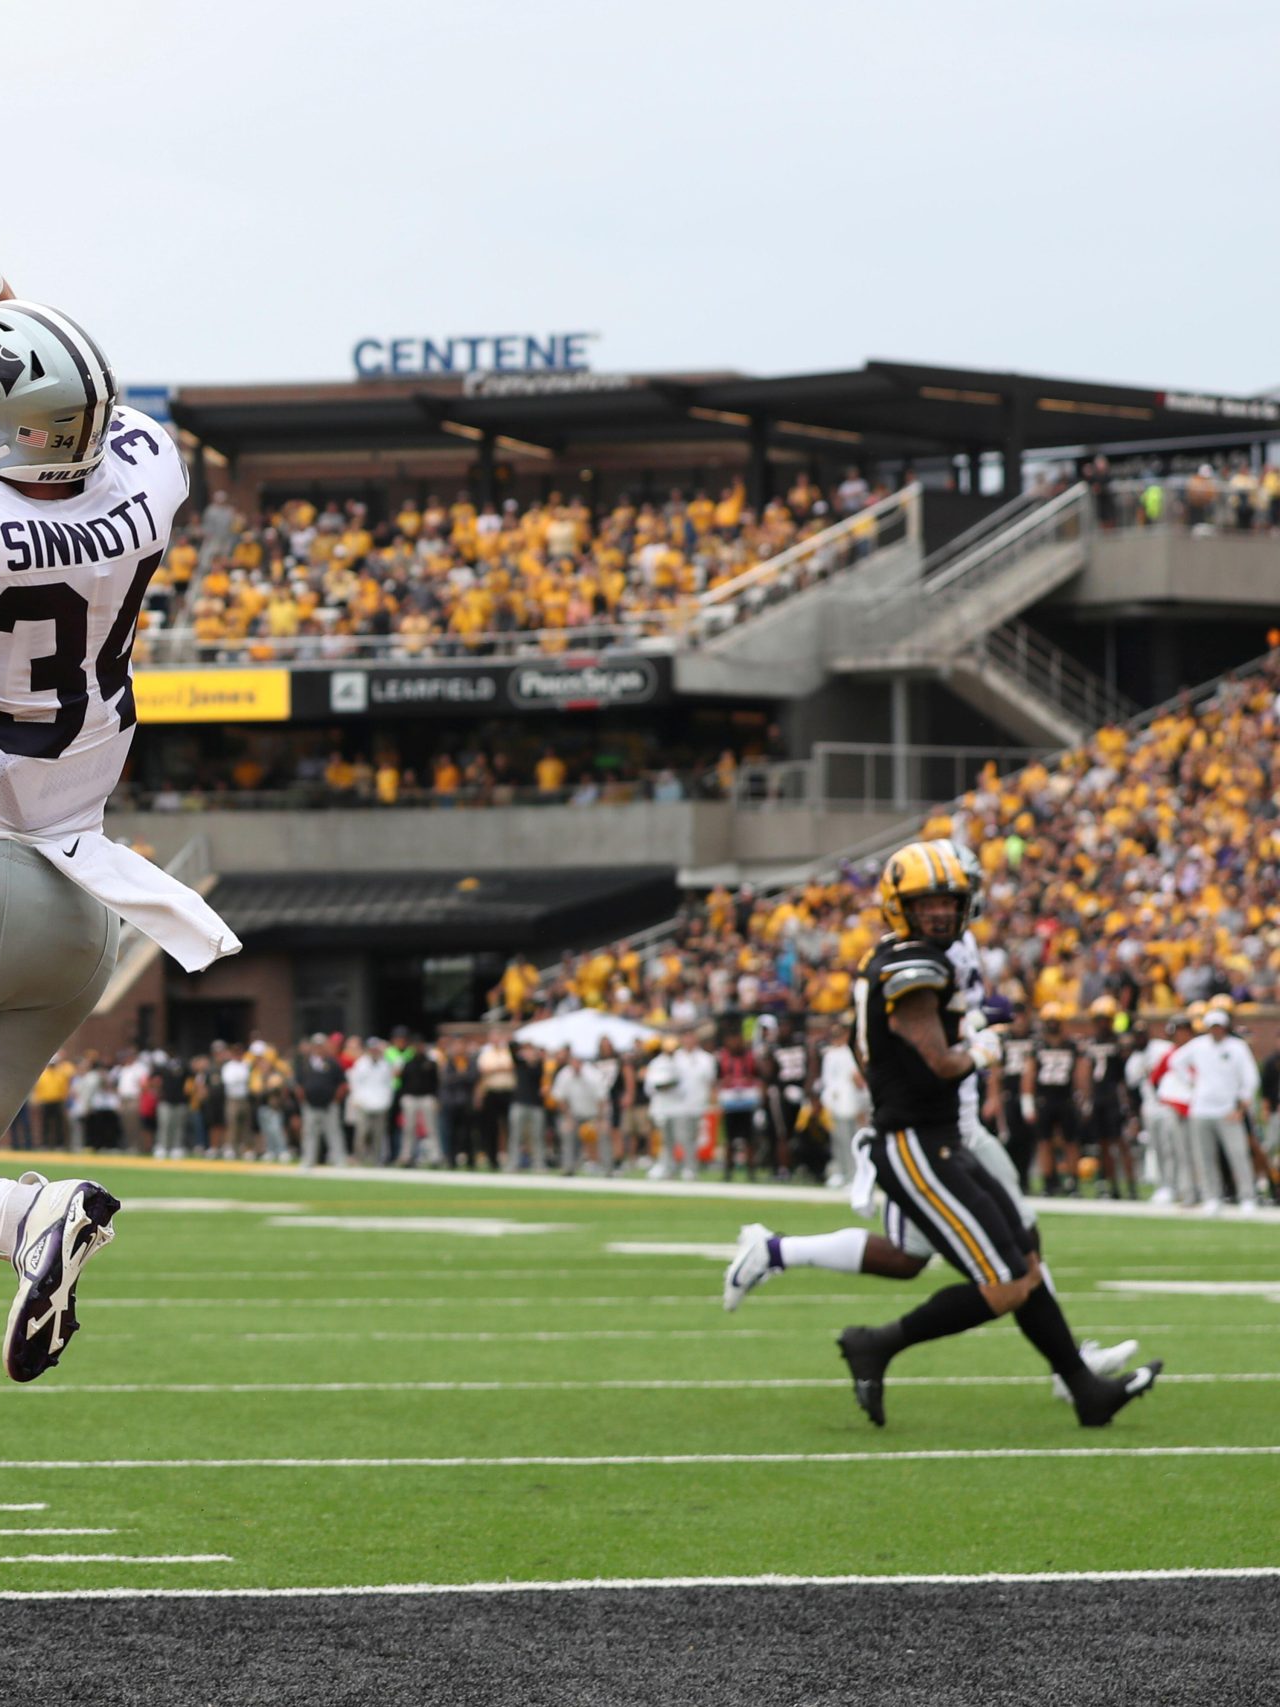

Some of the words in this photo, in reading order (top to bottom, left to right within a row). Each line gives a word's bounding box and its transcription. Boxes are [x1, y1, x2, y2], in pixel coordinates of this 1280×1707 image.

[352, 332, 588, 377] CENTENE
[50, 434, 75, 449] 34
[0, 491, 159, 572] SINNOTT
[371, 677, 497, 703] LEARFIELD
